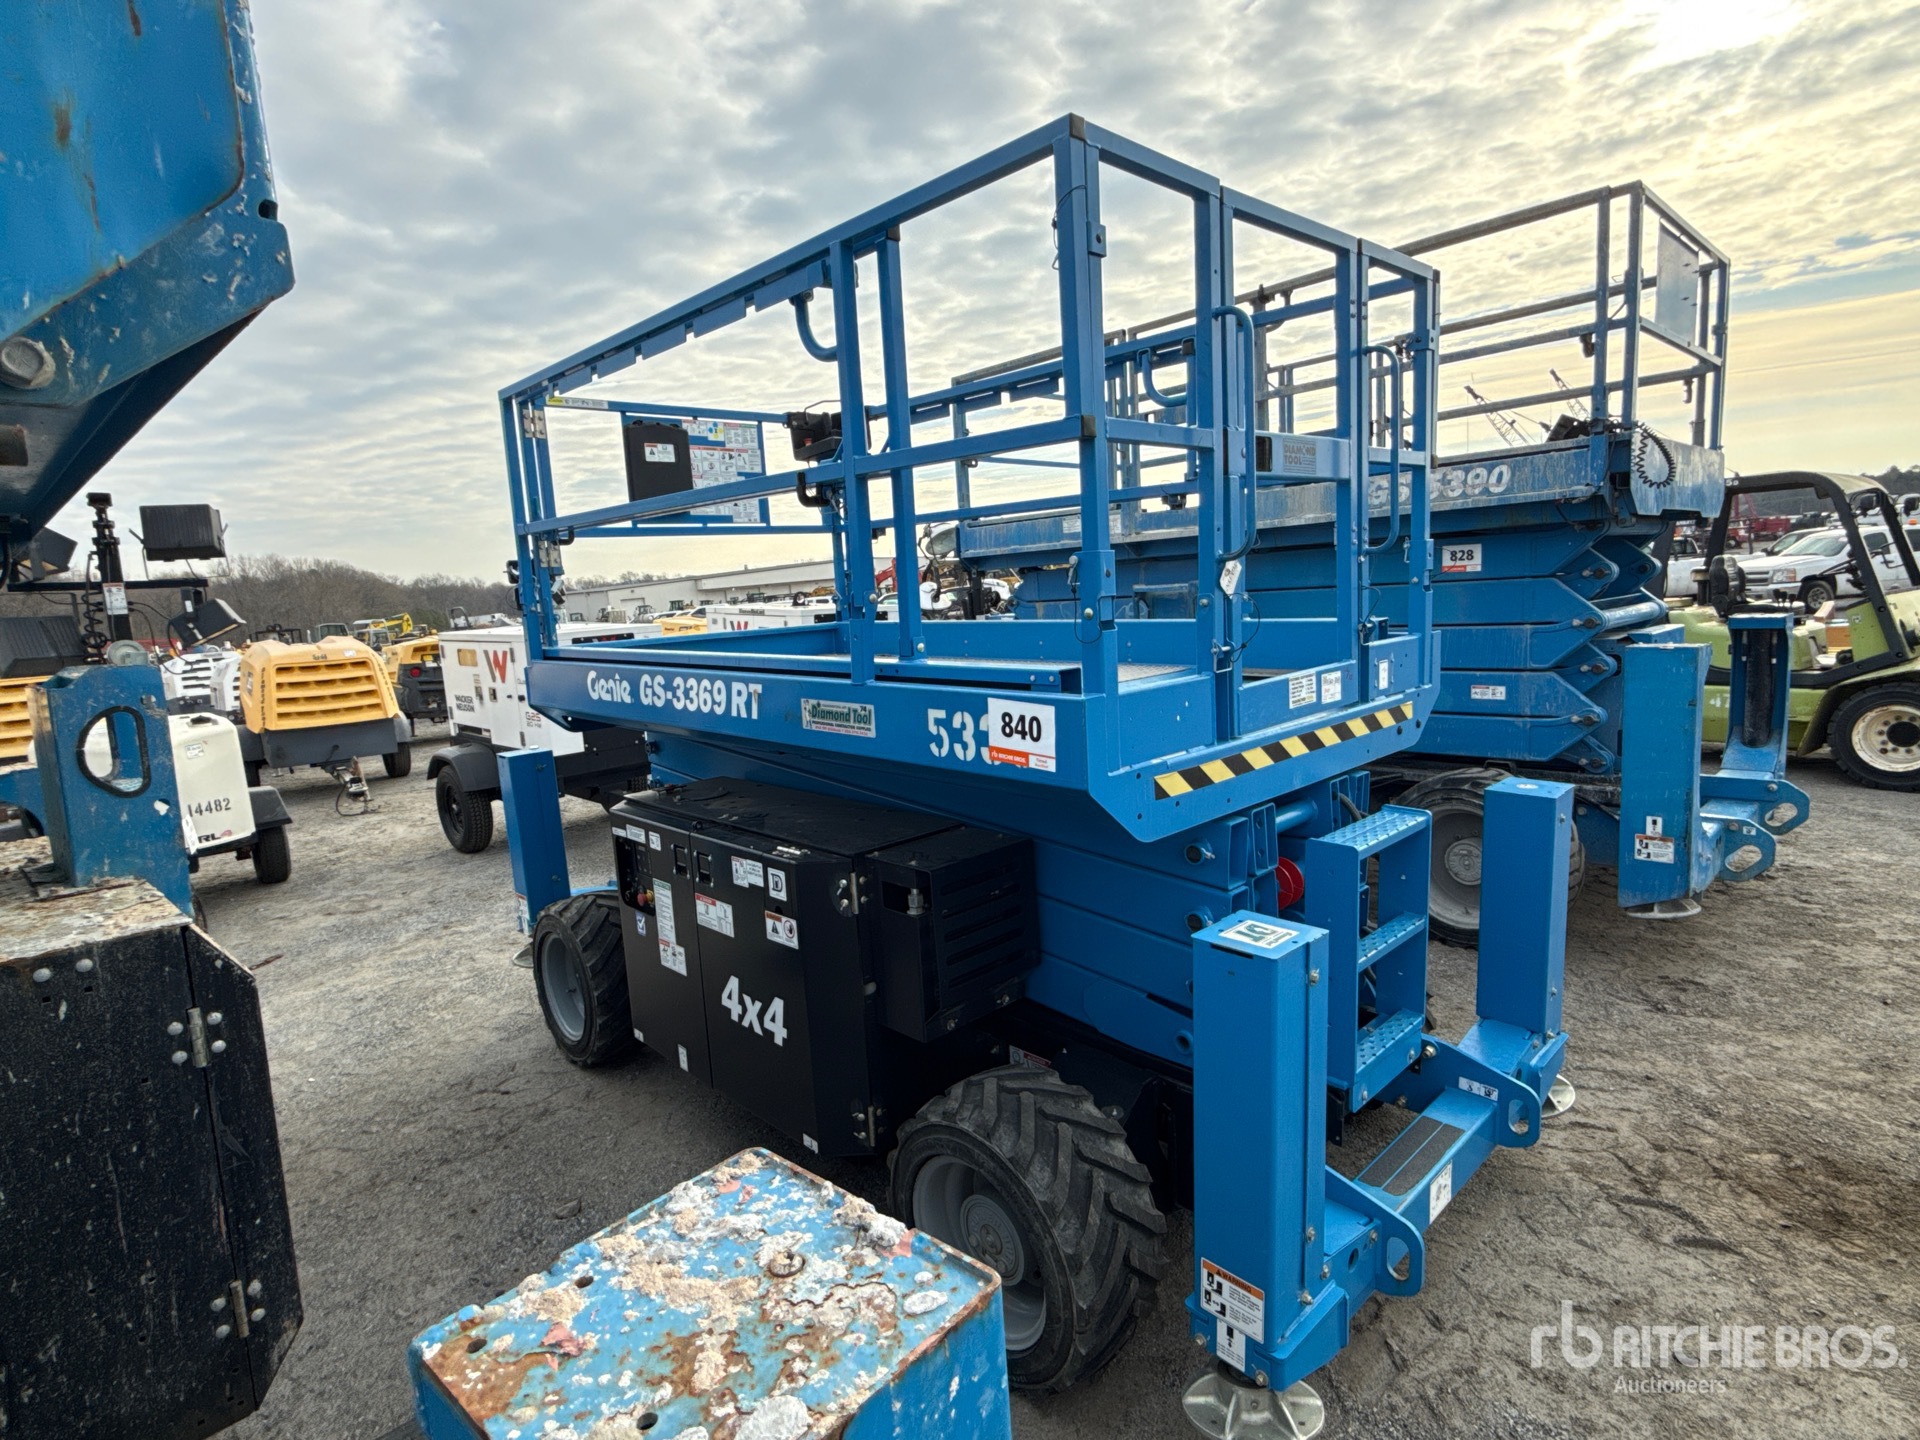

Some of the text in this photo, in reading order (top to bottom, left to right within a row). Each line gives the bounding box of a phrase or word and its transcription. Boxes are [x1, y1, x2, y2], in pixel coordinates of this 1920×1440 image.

[1450, 549, 1474, 562] 828
[587, 670, 762, 720] Genie GS-3369 RT
[811, 702, 872, 725] Diamond Tool
[1001, 712, 1042, 742] 840
[187, 797, 232, 817] 14482
[721, 974, 788, 1047] 4x4
[1219, 1270, 1253, 1294] WARNING
